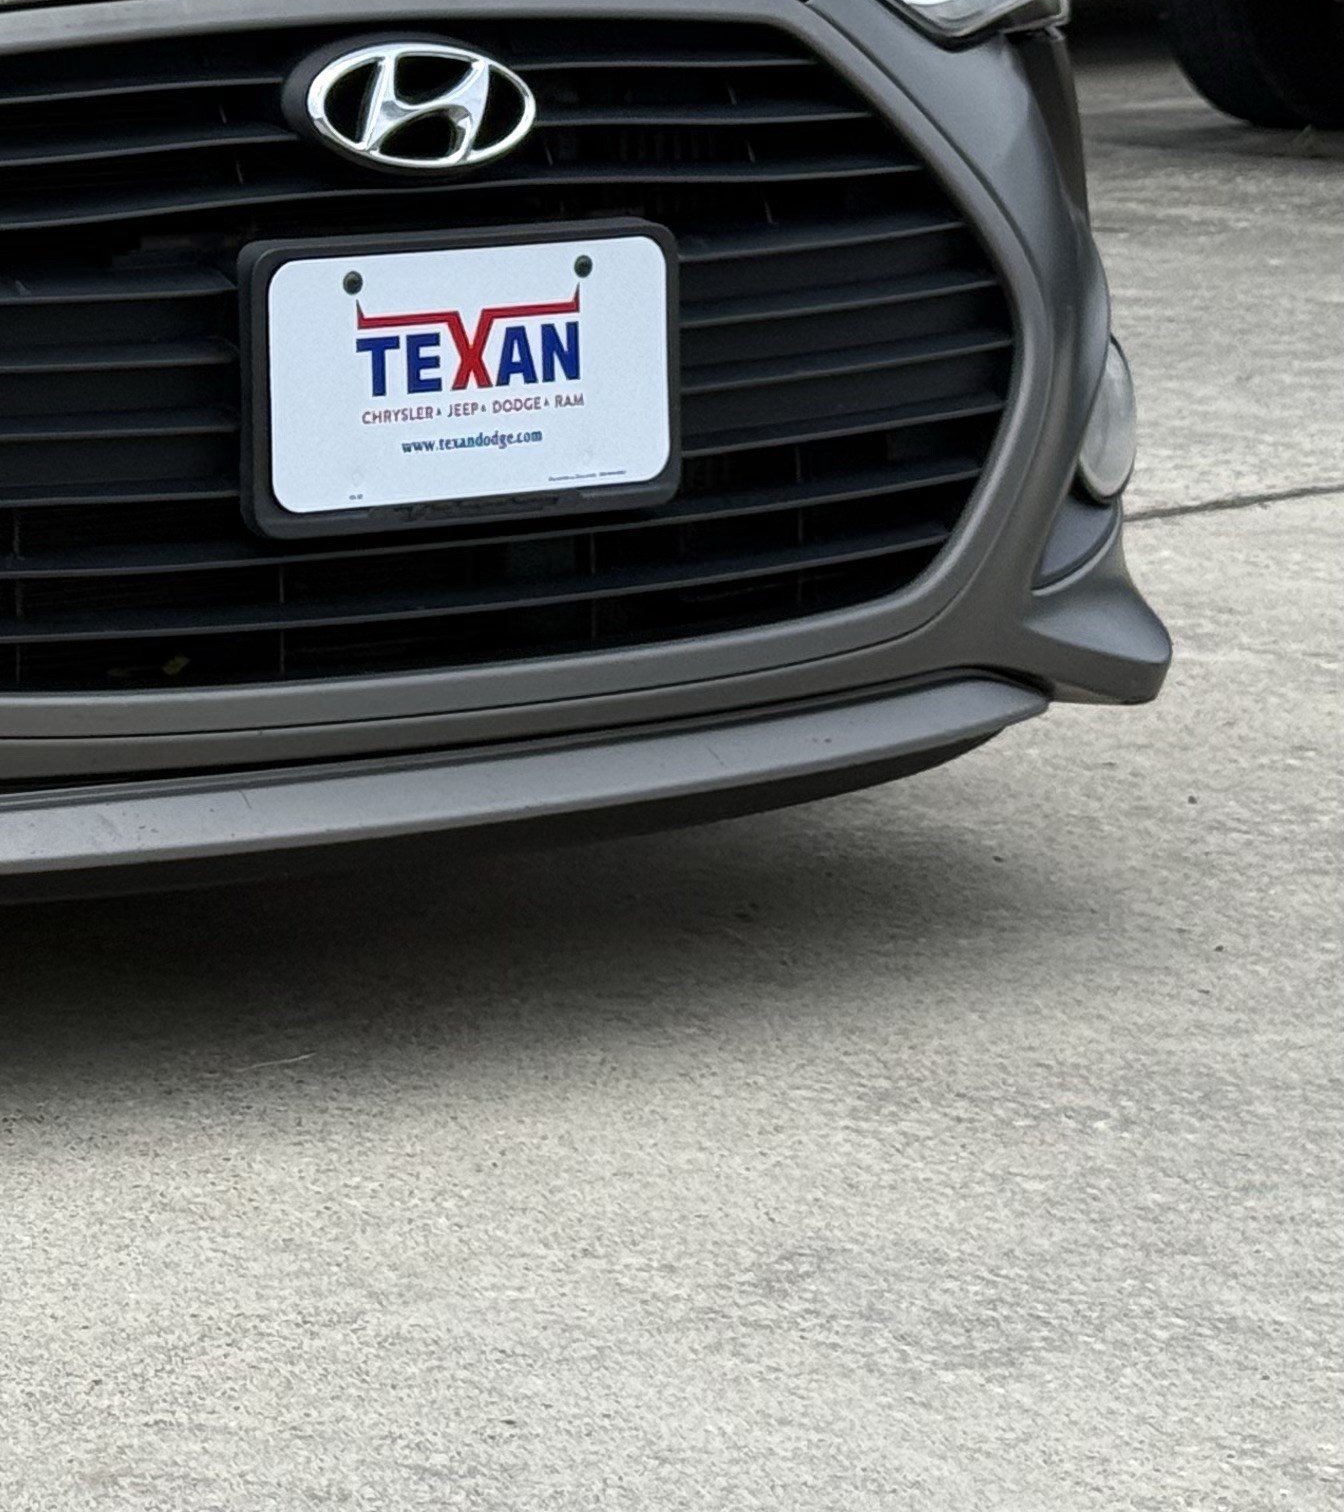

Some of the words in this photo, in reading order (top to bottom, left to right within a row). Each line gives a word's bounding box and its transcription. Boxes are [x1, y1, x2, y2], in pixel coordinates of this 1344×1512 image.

[355, 306, 581, 397] TEXAN
[362, 406, 434, 425] CHRYSLER
[447, 401, 479, 418] JEEP
[492, 396, 542, 414] DODGE
[554, 393, 585, 408] RAM
[401, 429, 543, 454] www.texandodge.com
